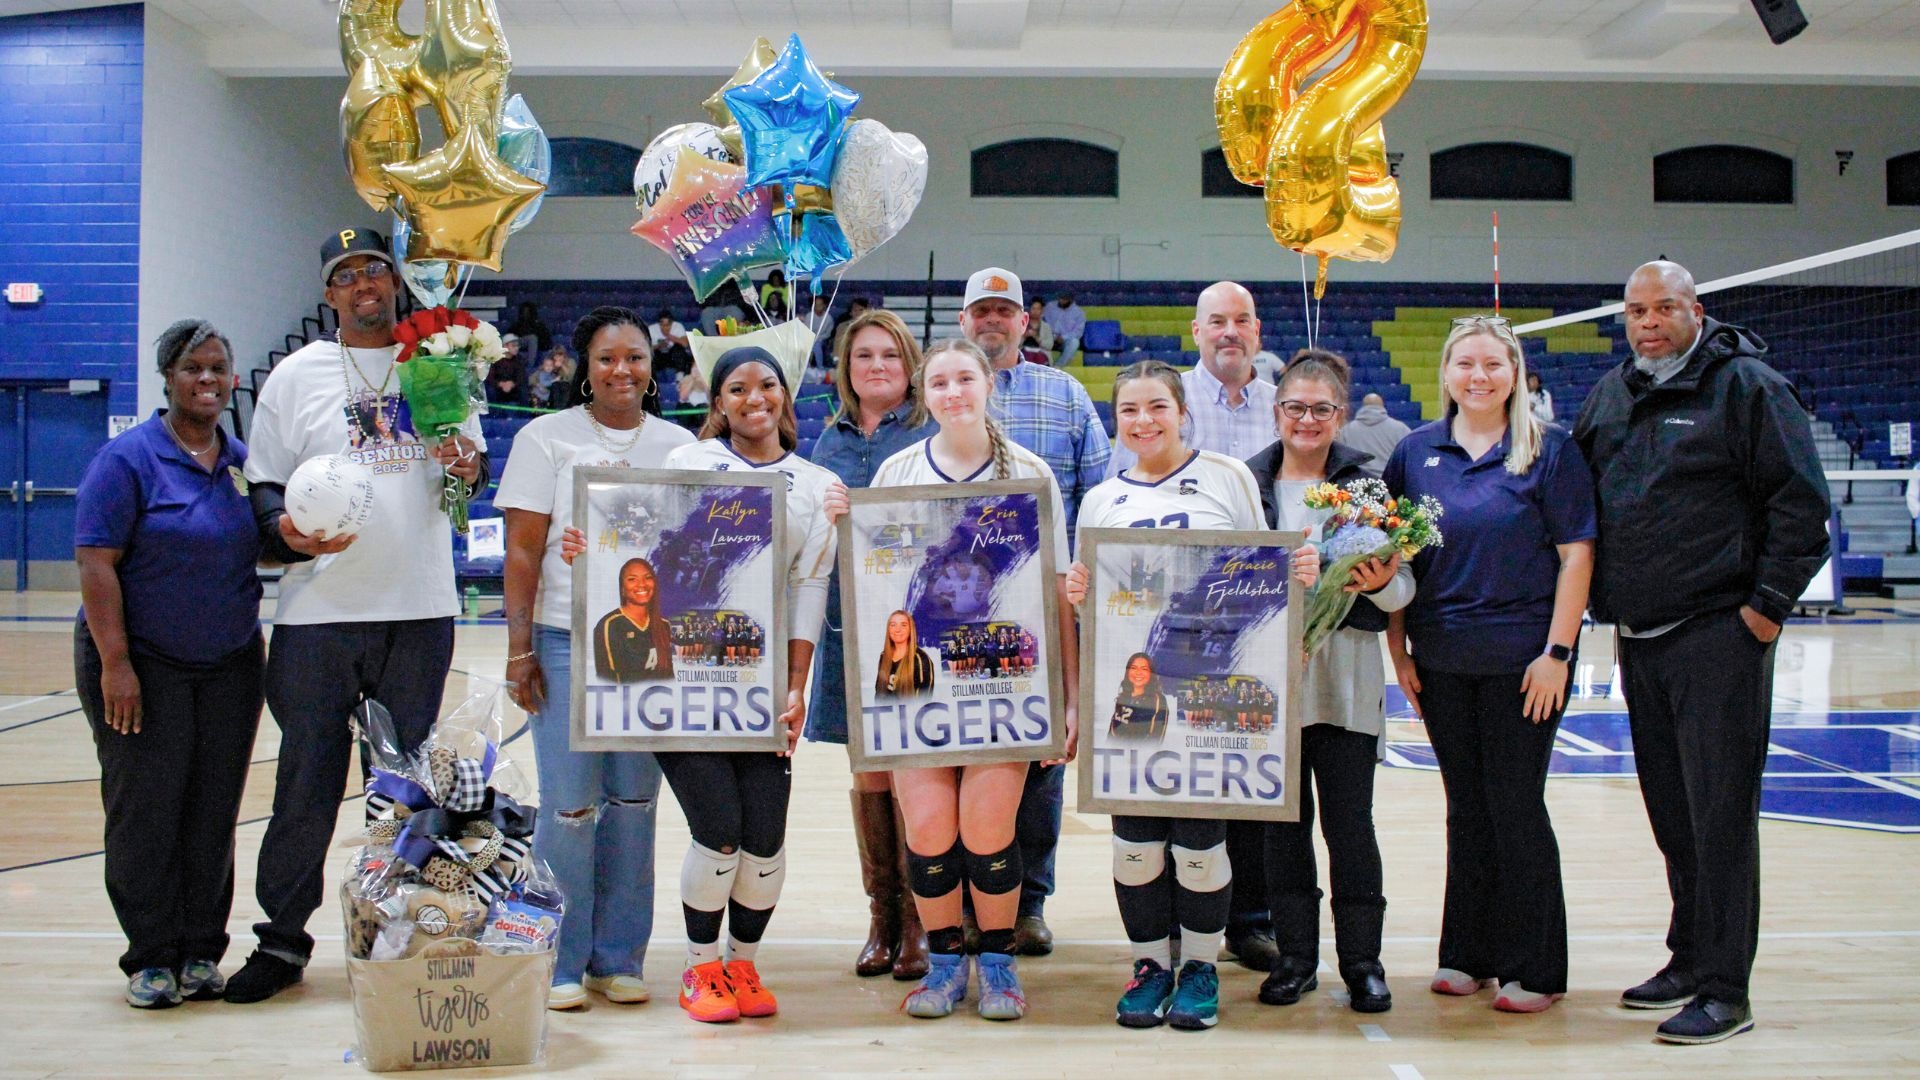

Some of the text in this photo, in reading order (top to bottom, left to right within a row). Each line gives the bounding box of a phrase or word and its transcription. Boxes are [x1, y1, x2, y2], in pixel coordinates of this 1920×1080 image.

[1390, 162, 1400, 178] E
[1839, 160, 1849, 176] F
[671, 190, 761, 261] AWESOME!
[339, 229, 356, 249] P
[13, 284, 34, 300] EXIT
[350, 443, 427, 465] SENIOR
[374, 462, 409, 475] 2025
[707, 499, 759, 526] Katlyn
[976, 505, 1019, 527] Erin
[710, 527, 762, 548] Lawson
[969, 527, 1025, 555] Nelson
[1222, 556, 1277, 580] Gracie
[1205, 579, 1288, 609] Fjeldstad
[677, 670, 710, 683] STILLMAN
[710, 671, 738, 683] COLLEGE
[951, 683, 985, 697] STILLMAN
[985, 681, 1013, 695] COLLEGE
[585, 685, 772, 732] TIGERS
[862, 695, 1049, 751] TIGERS
[1185, 735, 1220, 748] STILLMAN
[1220, 737, 1249, 749] COLLEGE
[1092, 747, 1283, 800] TIGERS
[427, 957, 475, 980] STILLMAN
[413, 984, 490, 1034] tigers
[413, 1038, 490, 1063] LAWSON
